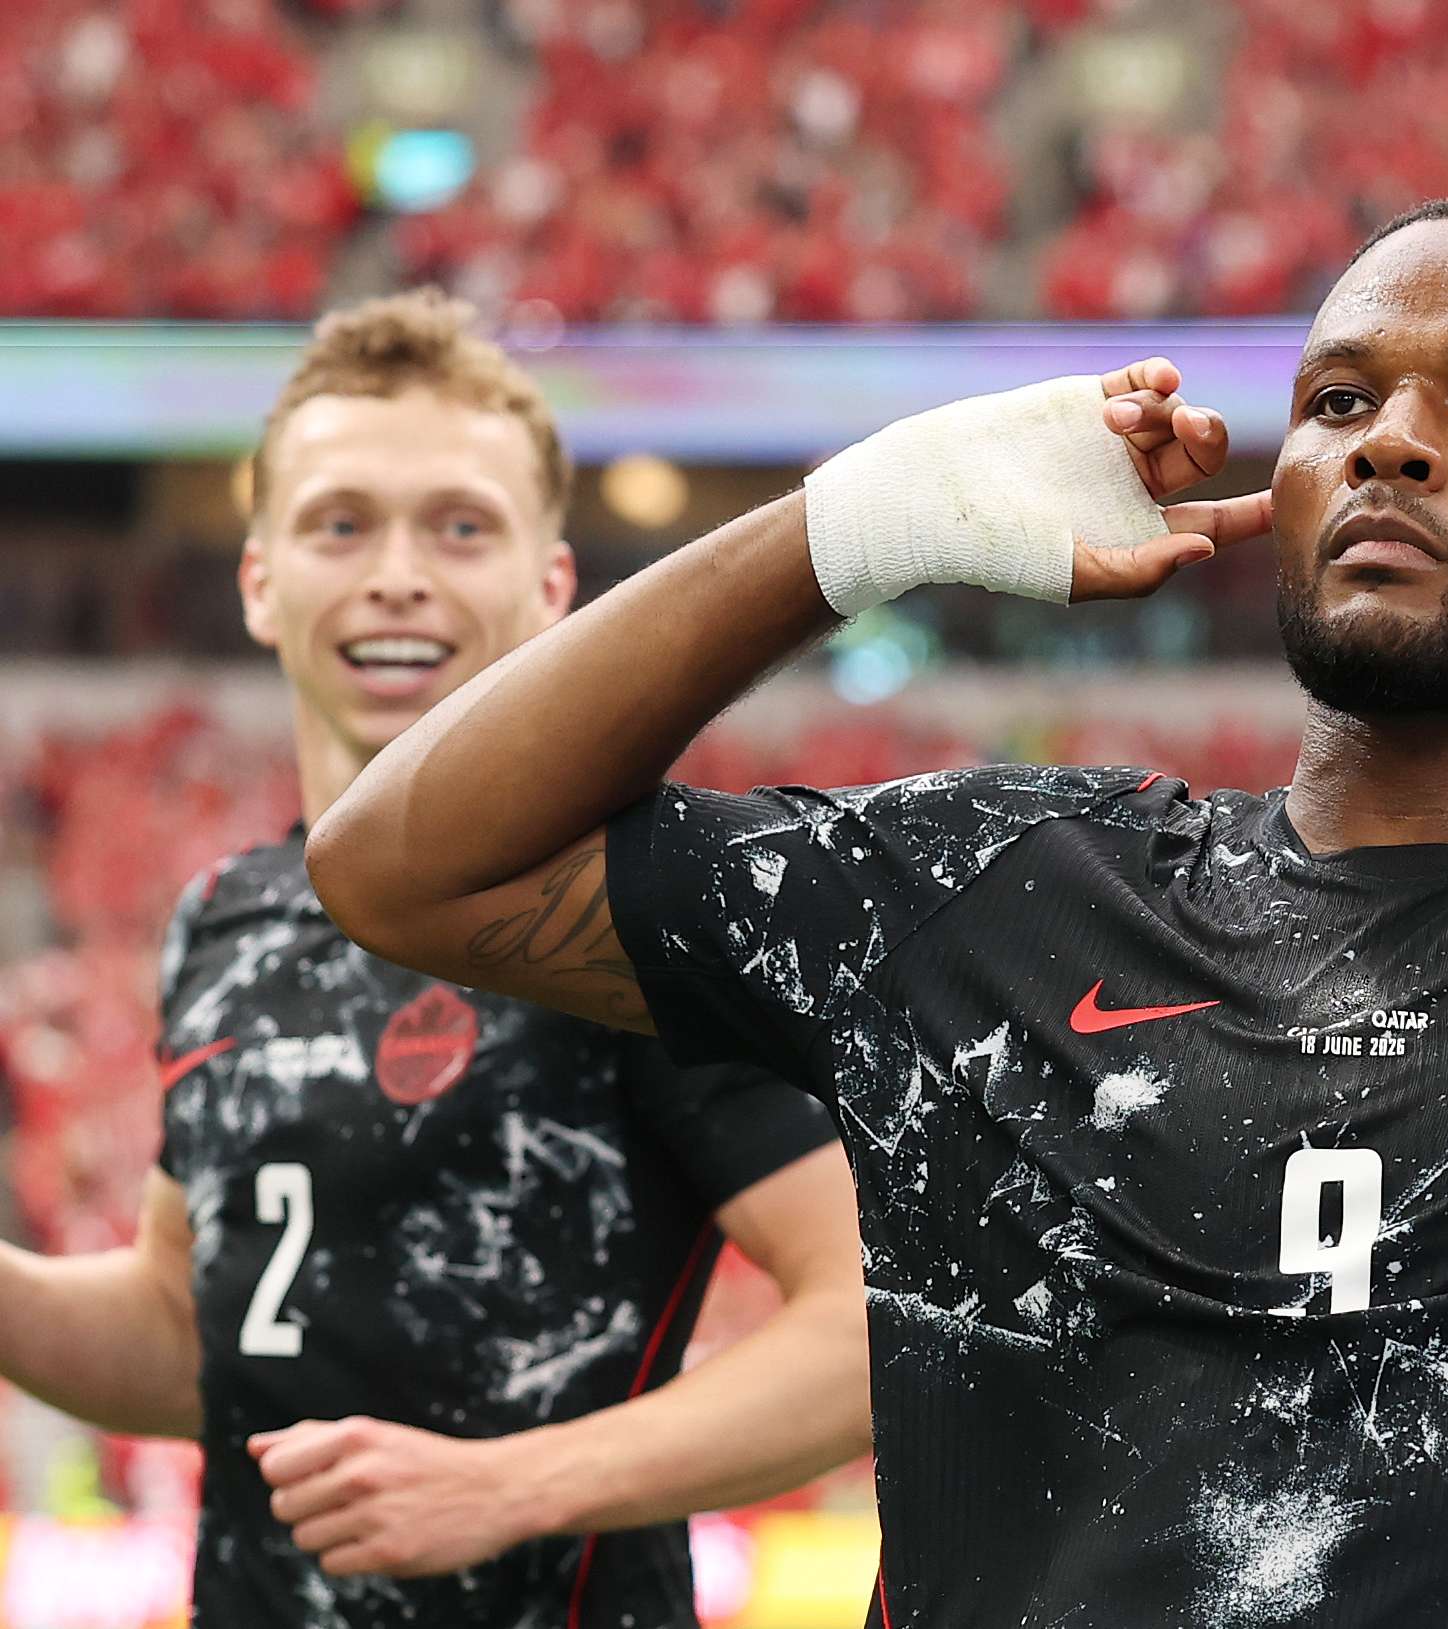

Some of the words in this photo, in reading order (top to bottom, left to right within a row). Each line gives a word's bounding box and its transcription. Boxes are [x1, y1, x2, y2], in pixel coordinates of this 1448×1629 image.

[1301, 1035, 1316, 1054] 18
[1322, 1036, 1362, 1055] JUNE
[1369, 1037, 1406, 1056] 2026
[1371, 1010, 1429, 1029] QATAR
[239, 1162, 314, 1357] 2
[1270, 1148, 1383, 1316] 9
